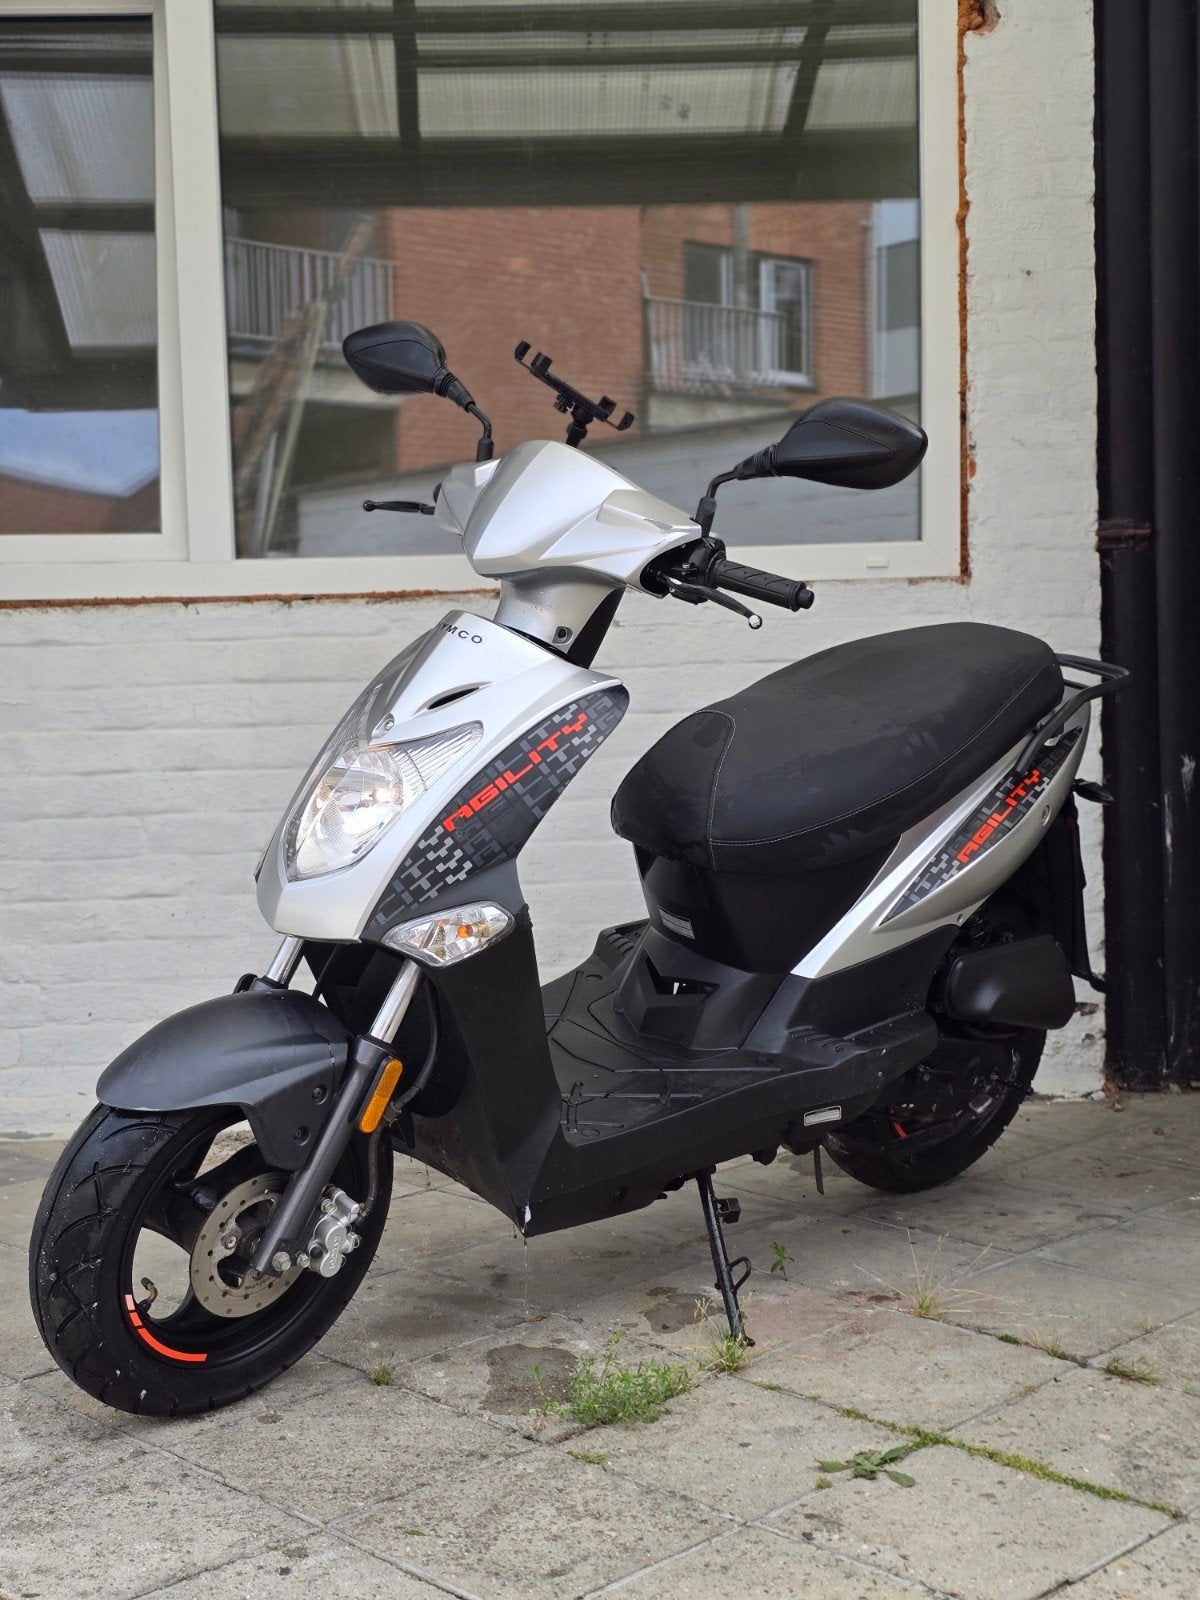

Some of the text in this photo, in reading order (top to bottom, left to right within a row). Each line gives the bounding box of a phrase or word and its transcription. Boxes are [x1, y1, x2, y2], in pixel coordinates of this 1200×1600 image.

[438, 622, 483, 644] YMCO
[442, 712, 587, 832] AGILITY
[956, 769, 1040, 863] AGILITY
